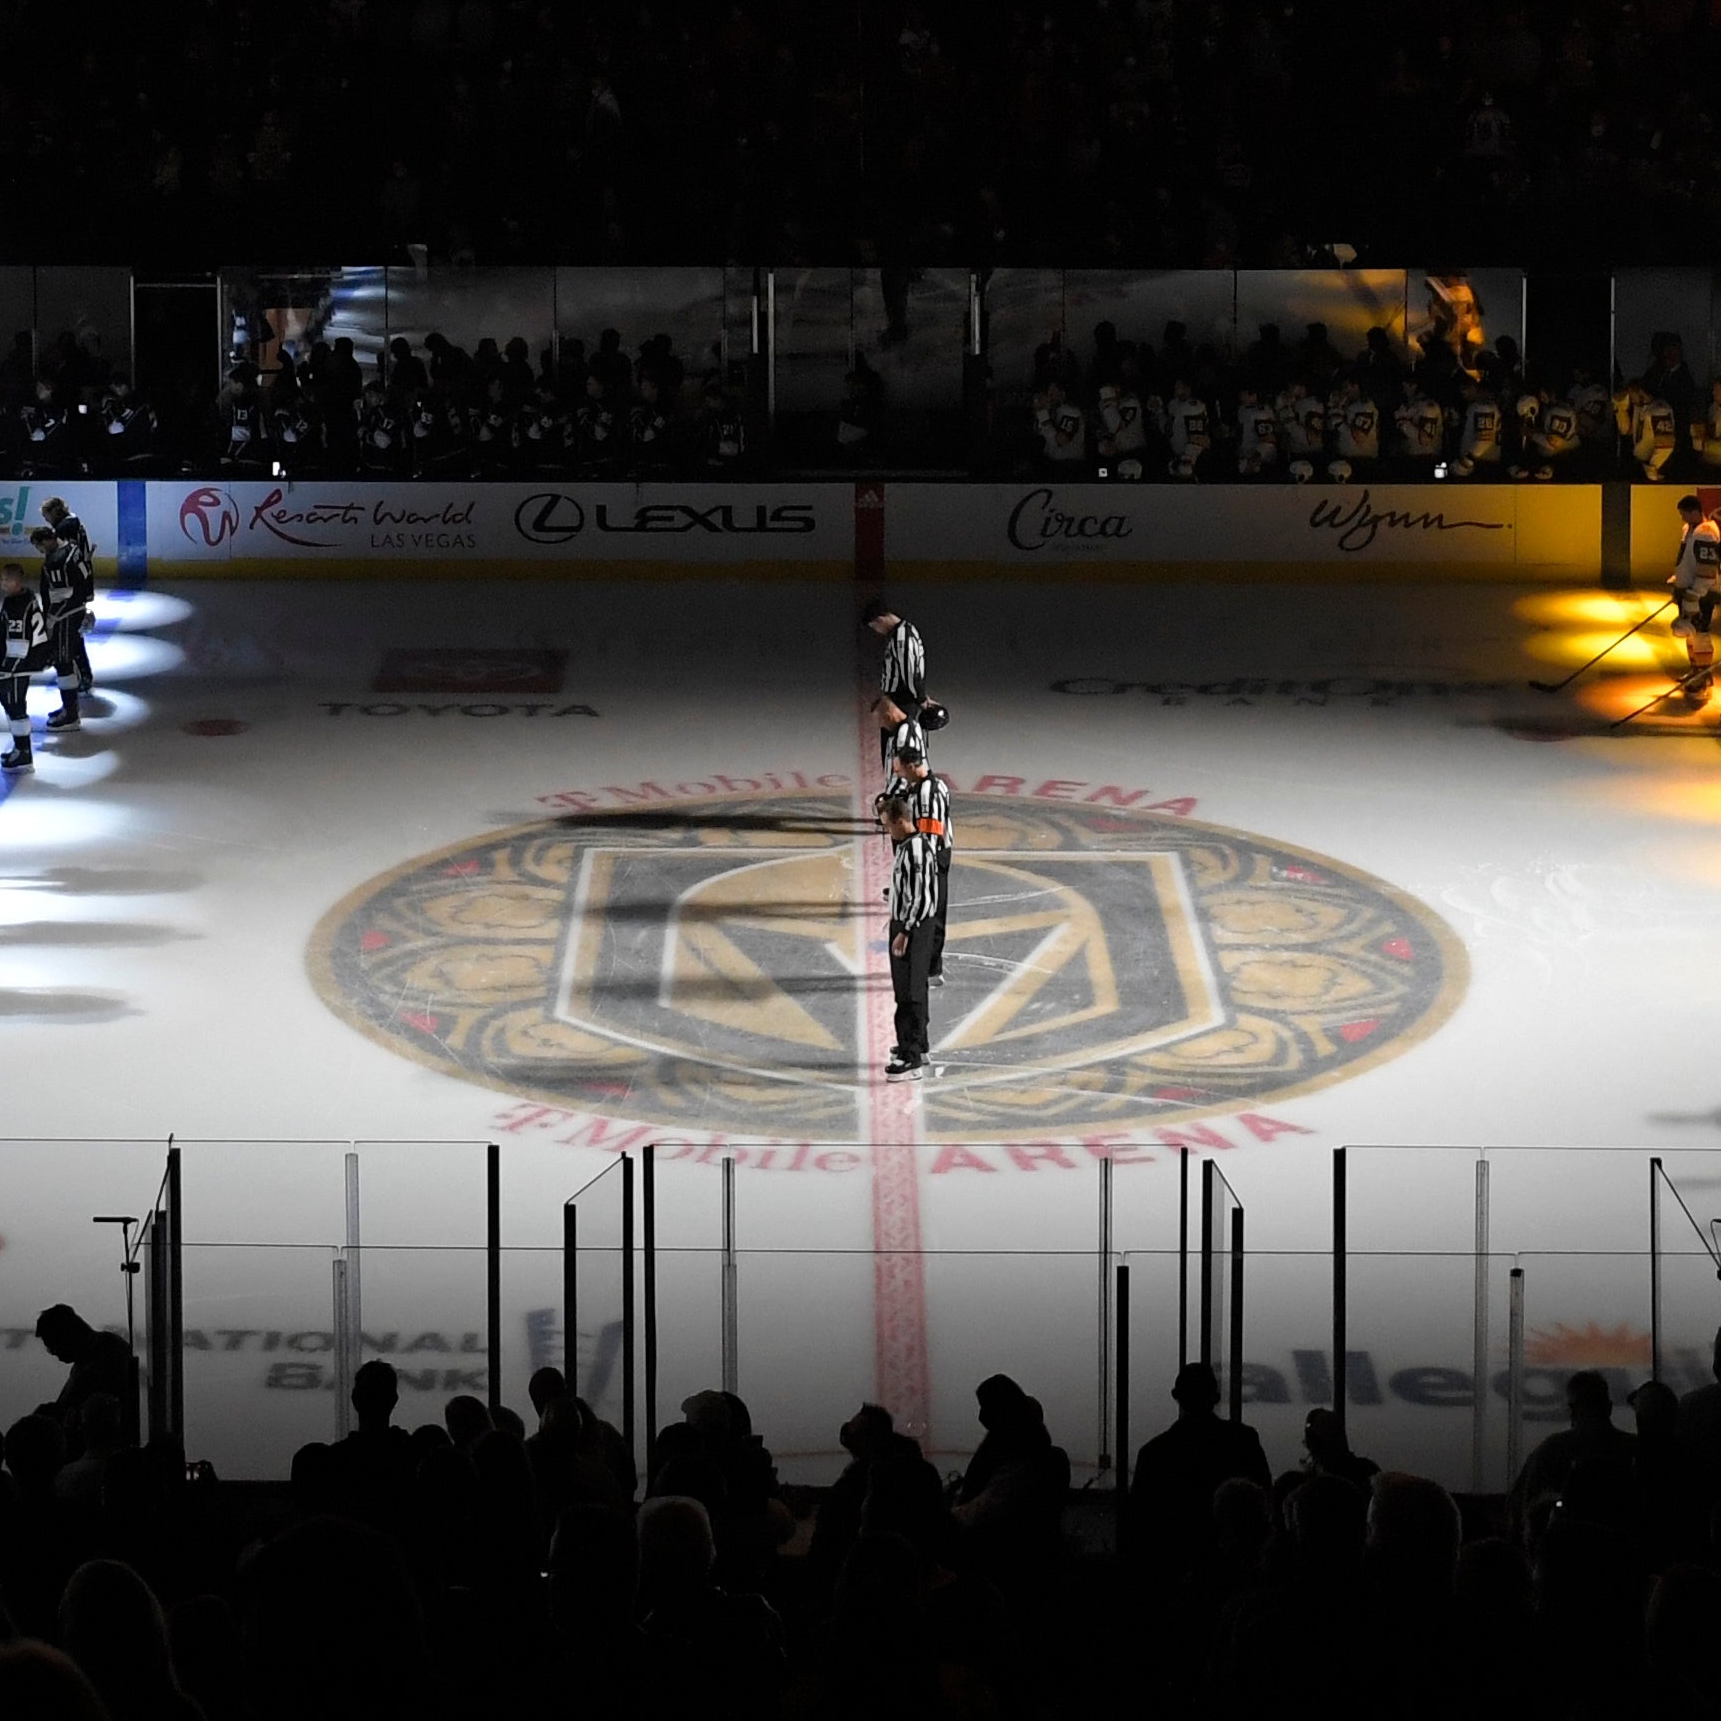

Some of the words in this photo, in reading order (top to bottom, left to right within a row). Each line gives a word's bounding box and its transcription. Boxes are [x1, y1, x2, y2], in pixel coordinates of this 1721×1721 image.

[372, 500, 475, 526] World
[595, 505, 816, 533] LEXUS
[1007, 488, 1133, 551] Circa
[370, 533, 407, 548] LAS
[412, 533, 476, 549] VEGAS
[50, 569, 61, 582] 11
[8, 619, 23, 633] 23
[317, 701, 599, 718] TOYOTA
[928, 1112, 1318, 1175] ARENA
[110, 1327, 489, 1355] ATIONAL
[264, 1361, 489, 1392] BNK
